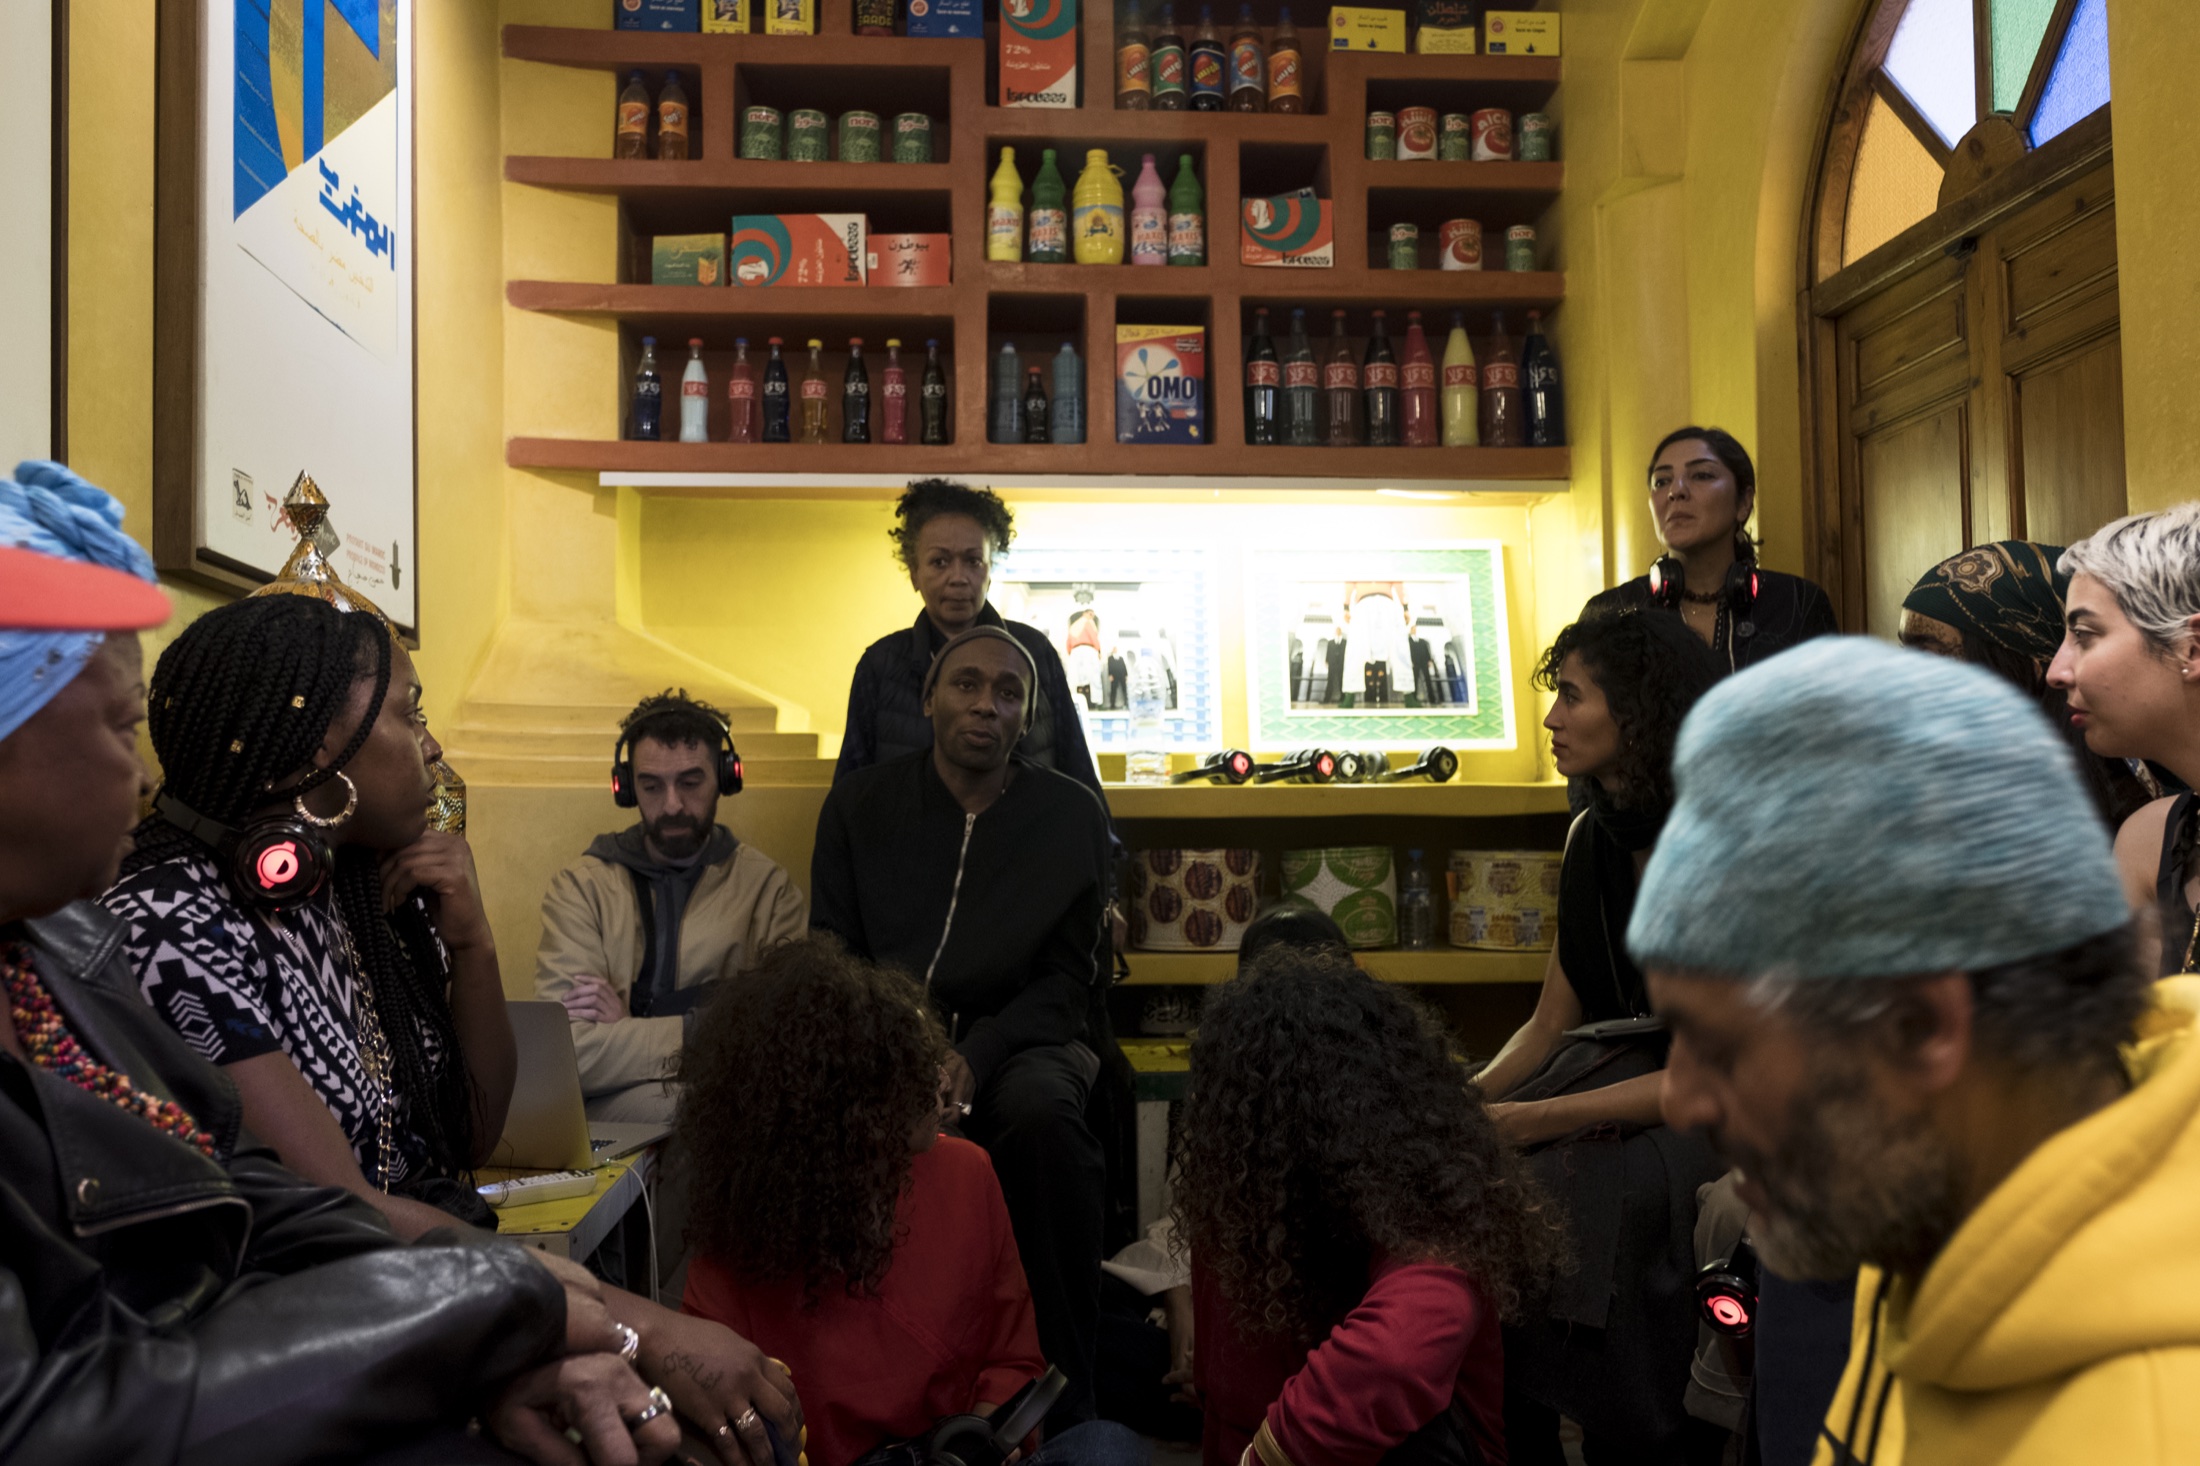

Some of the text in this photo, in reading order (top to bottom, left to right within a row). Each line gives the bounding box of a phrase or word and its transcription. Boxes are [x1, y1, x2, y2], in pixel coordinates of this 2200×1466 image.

[748, 111, 779, 125] nora
[848, 116, 879, 130] nora
[1148, 375, 1196, 400] OMO
